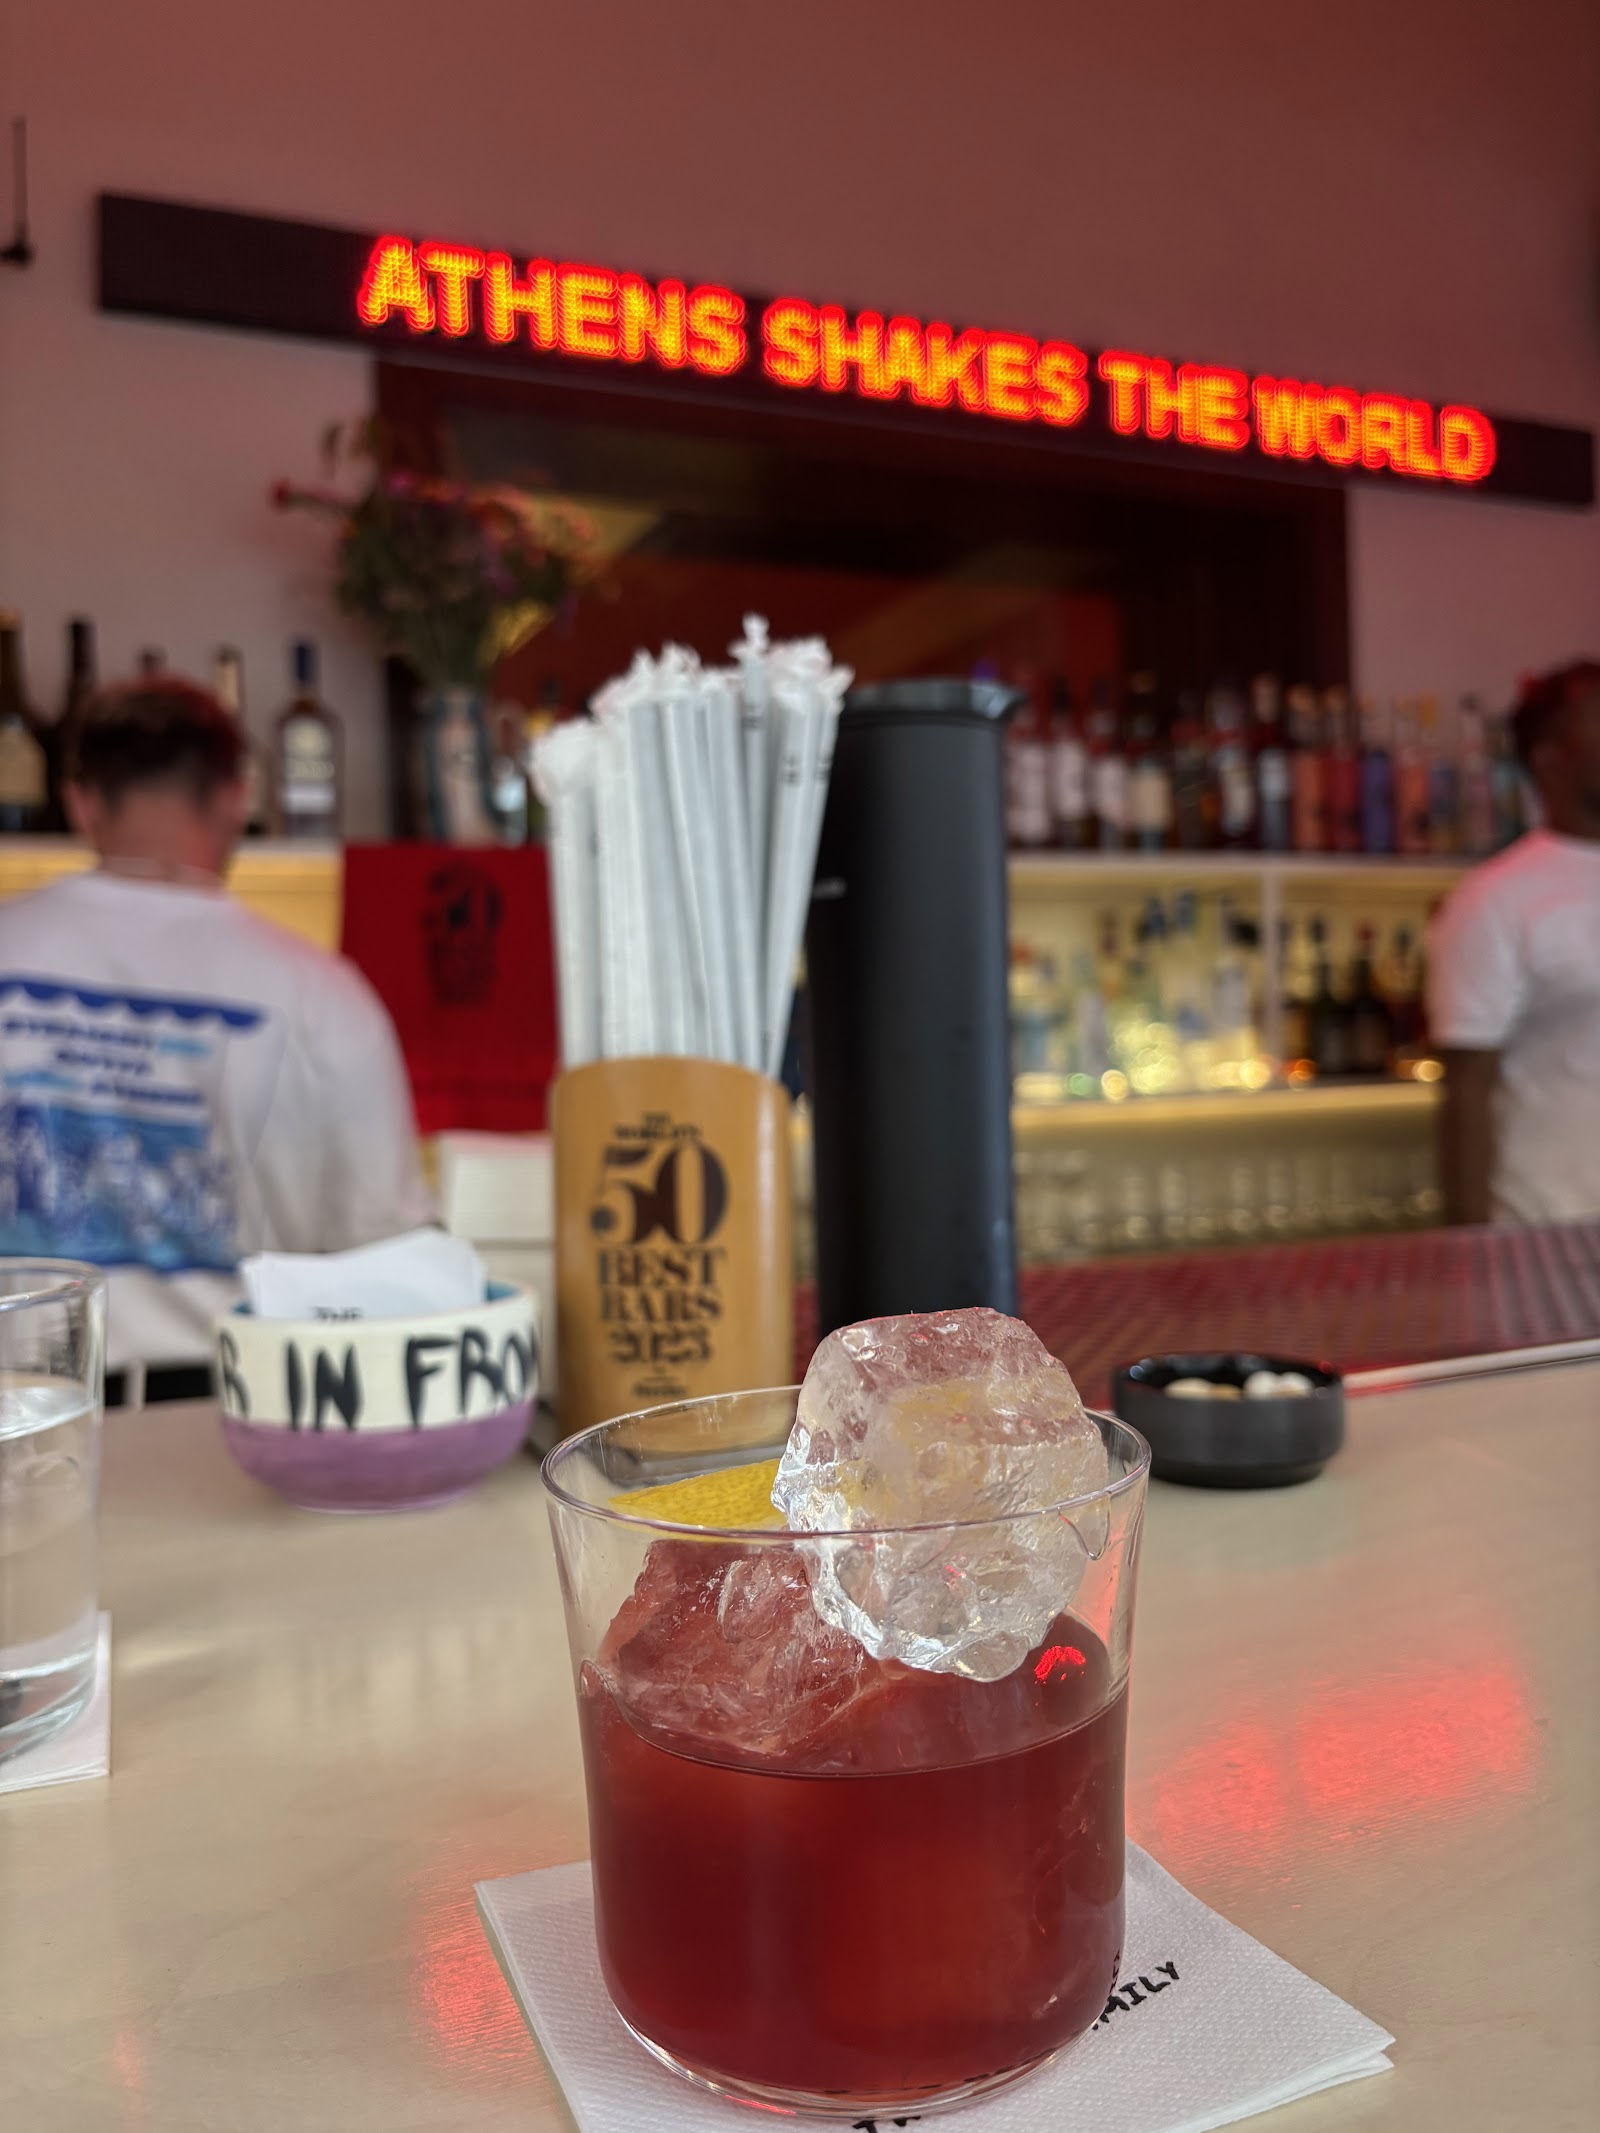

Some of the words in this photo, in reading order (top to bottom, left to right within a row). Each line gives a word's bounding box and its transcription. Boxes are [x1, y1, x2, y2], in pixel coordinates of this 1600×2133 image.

[357, 235, 747, 376] ATHENS
[762, 298, 1089, 428] SHAKES
[1098, 349, 1250, 450] THE
[1251, 375, 1497, 482] WORLD
[590, 1140, 729, 1245] 50
[285, 1338, 360, 1432] IN
